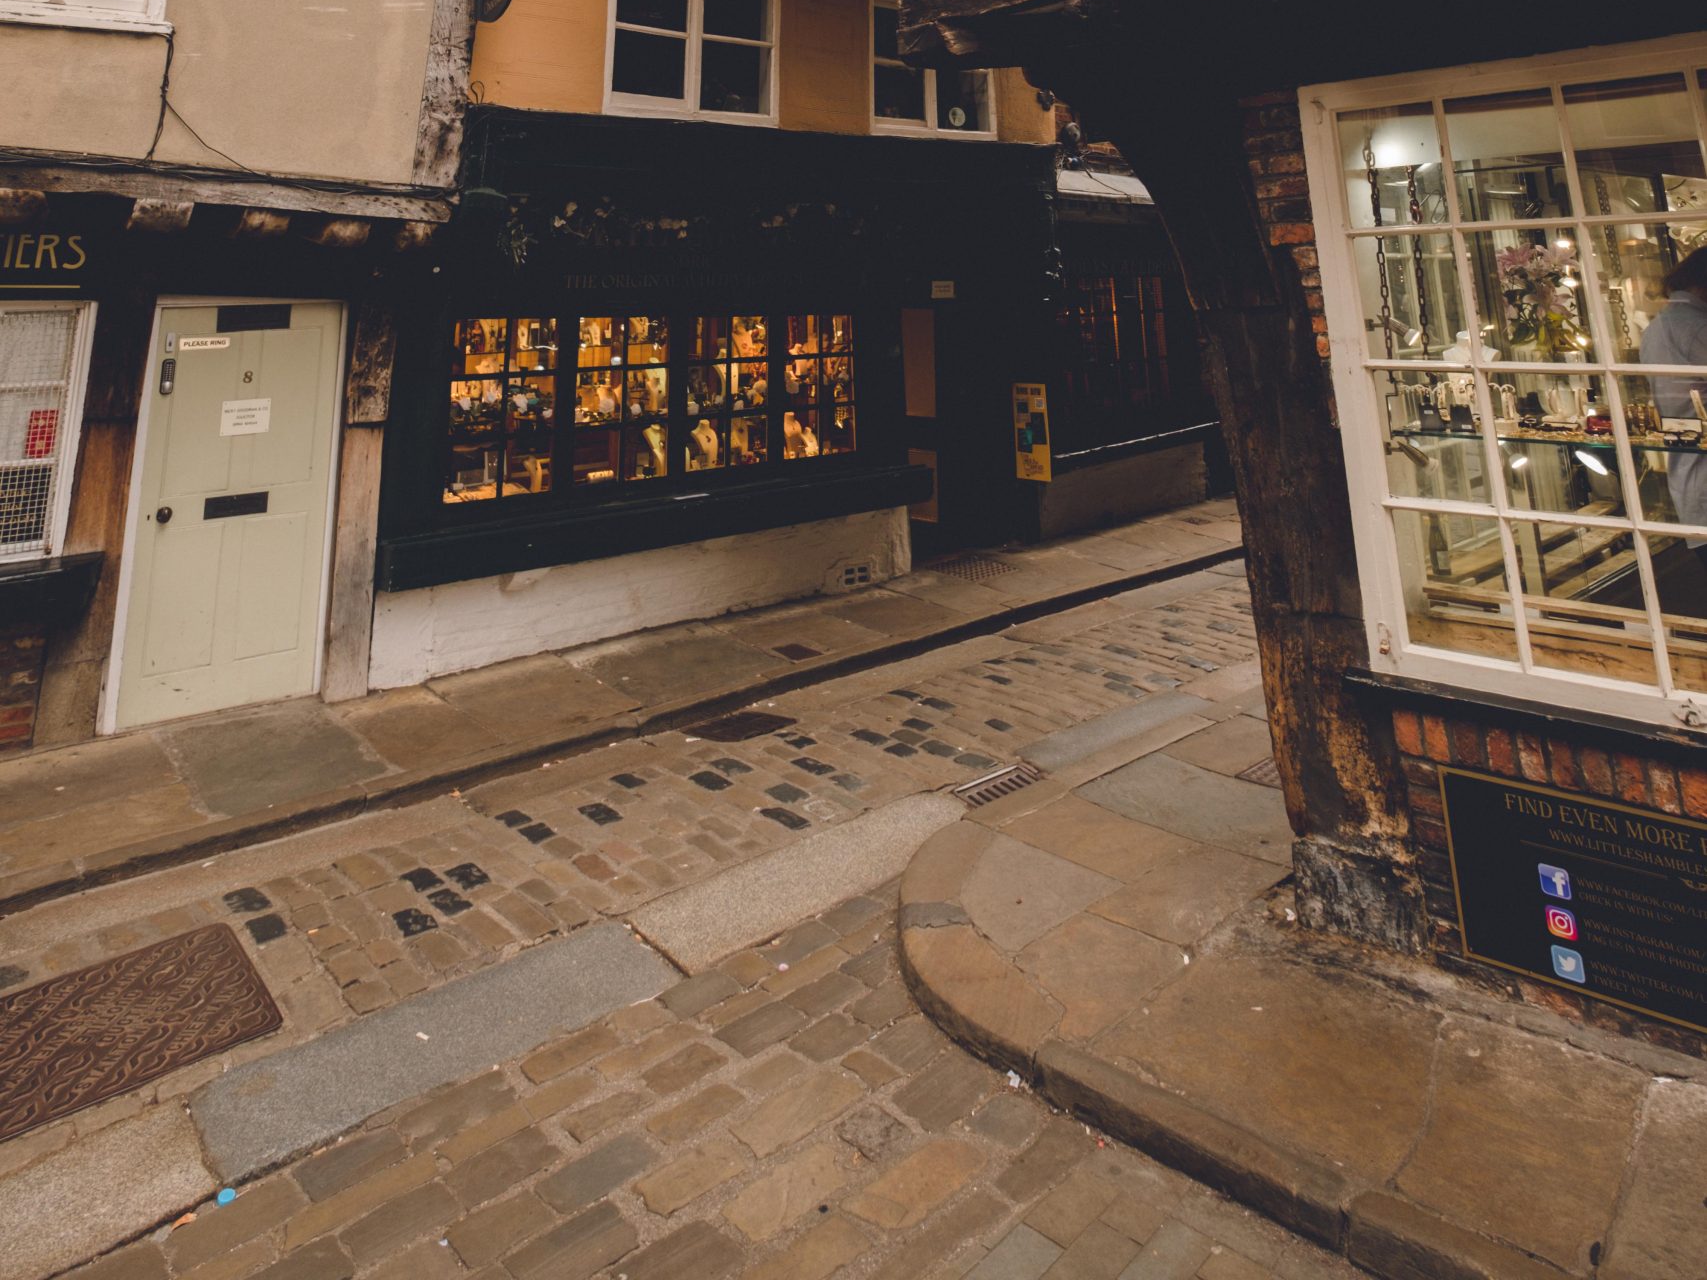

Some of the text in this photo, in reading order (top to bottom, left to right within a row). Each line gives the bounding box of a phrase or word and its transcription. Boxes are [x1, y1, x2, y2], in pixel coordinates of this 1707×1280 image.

[0, 233, 86, 270] IERS
[563, 273, 598, 289] THE
[243, 370, 253, 384] 8
[1504, 792, 1553, 819] FIND
[1559, 805, 1618, 835] EVEN
[1624, 820, 1694, 853] MORE
[1594, 975, 1629, 993] TWEET
